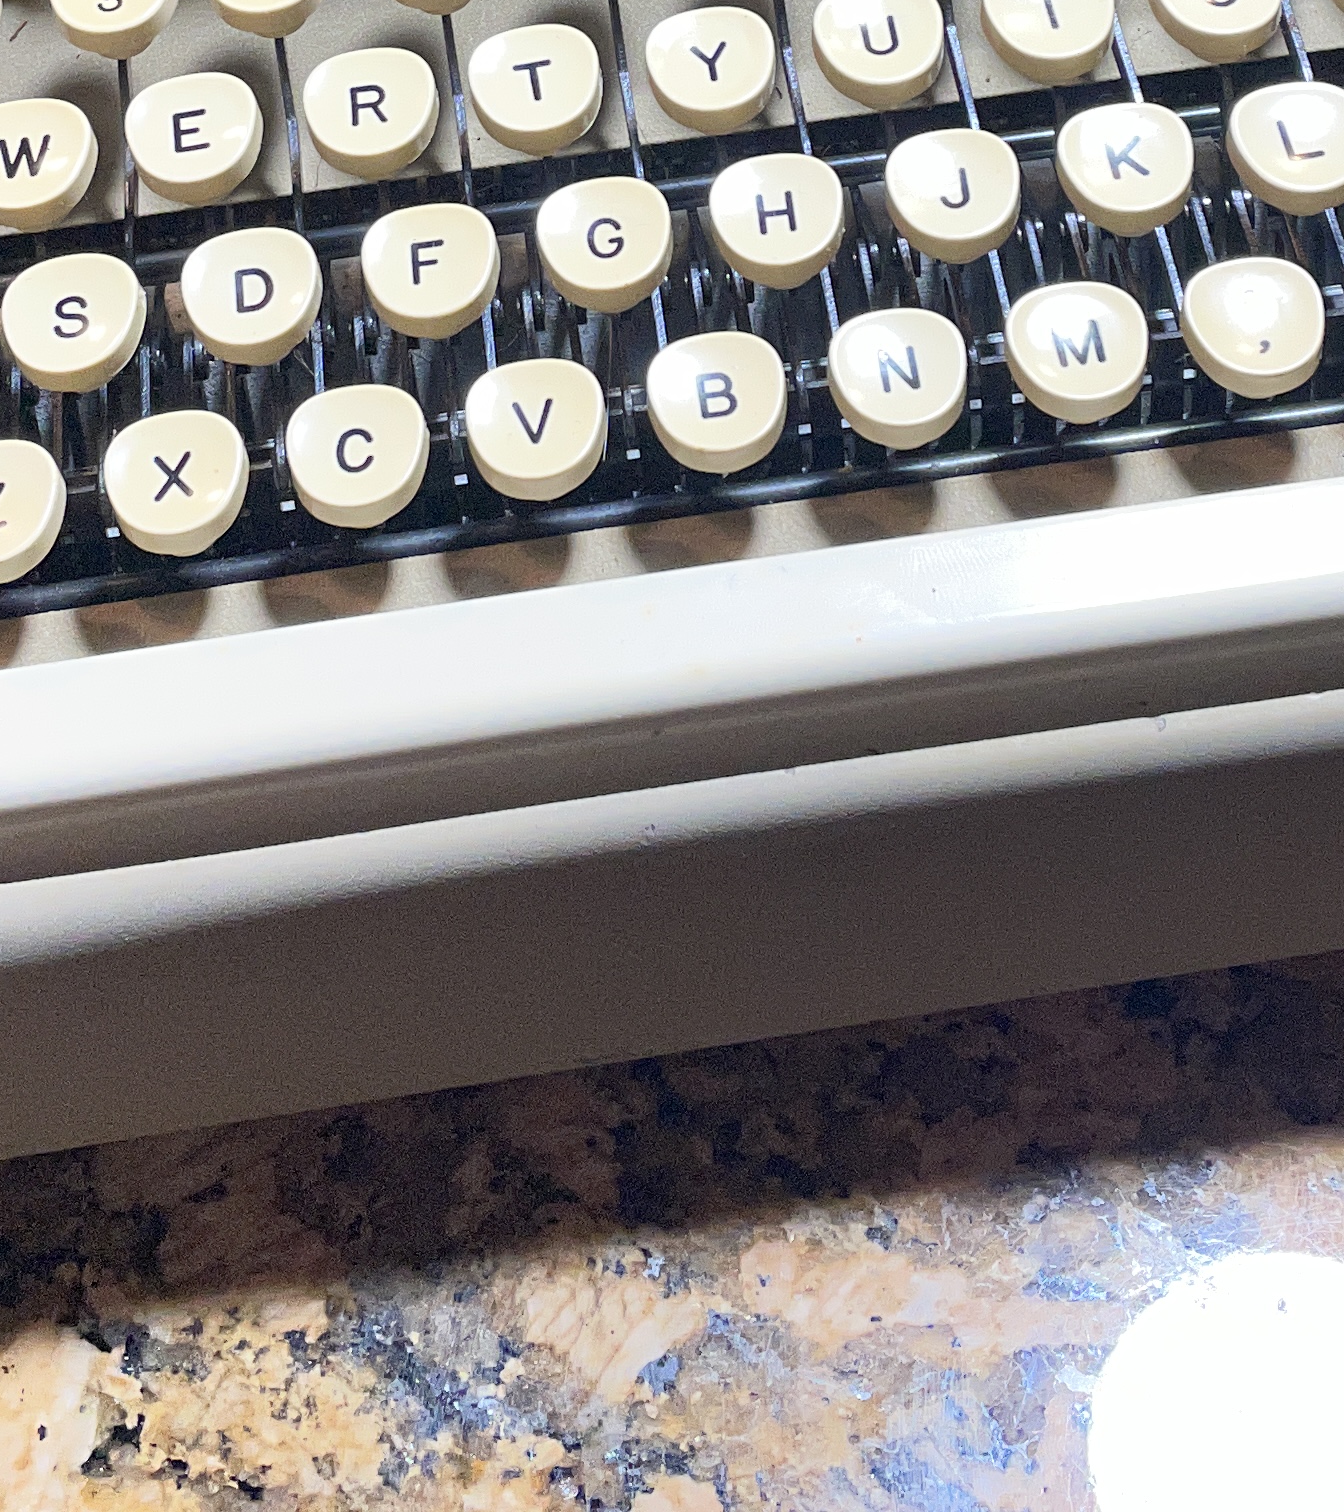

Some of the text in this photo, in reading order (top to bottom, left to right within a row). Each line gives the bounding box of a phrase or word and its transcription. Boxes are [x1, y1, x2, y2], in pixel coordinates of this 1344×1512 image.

[859, 14, 899, 56] U
[513, 59, 552, 101] T
[689, 41, 728, 82] Y
[350, 84, 389, 127] R
[173, 108, 209, 153] E
[1276, 119, 1325, 161] L
[0, 134, 51, 179] W
[1106, 134, 1151, 180] K
[939, 166, 972, 210] J
[756, 190, 798, 235] H
[586, 217, 625, 259] G
[410, 239, 445, 285] F
[236, 268, 275, 313] D
[53, 295, 89, 340] S
[1052, 319, 1108, 368] M
[878, 344, 923, 393] N
[696, 371, 736, 420] B
[512, 398, 553, 445] V
[336, 428, 375, 473] C
[153, 451, 193, 501] X
